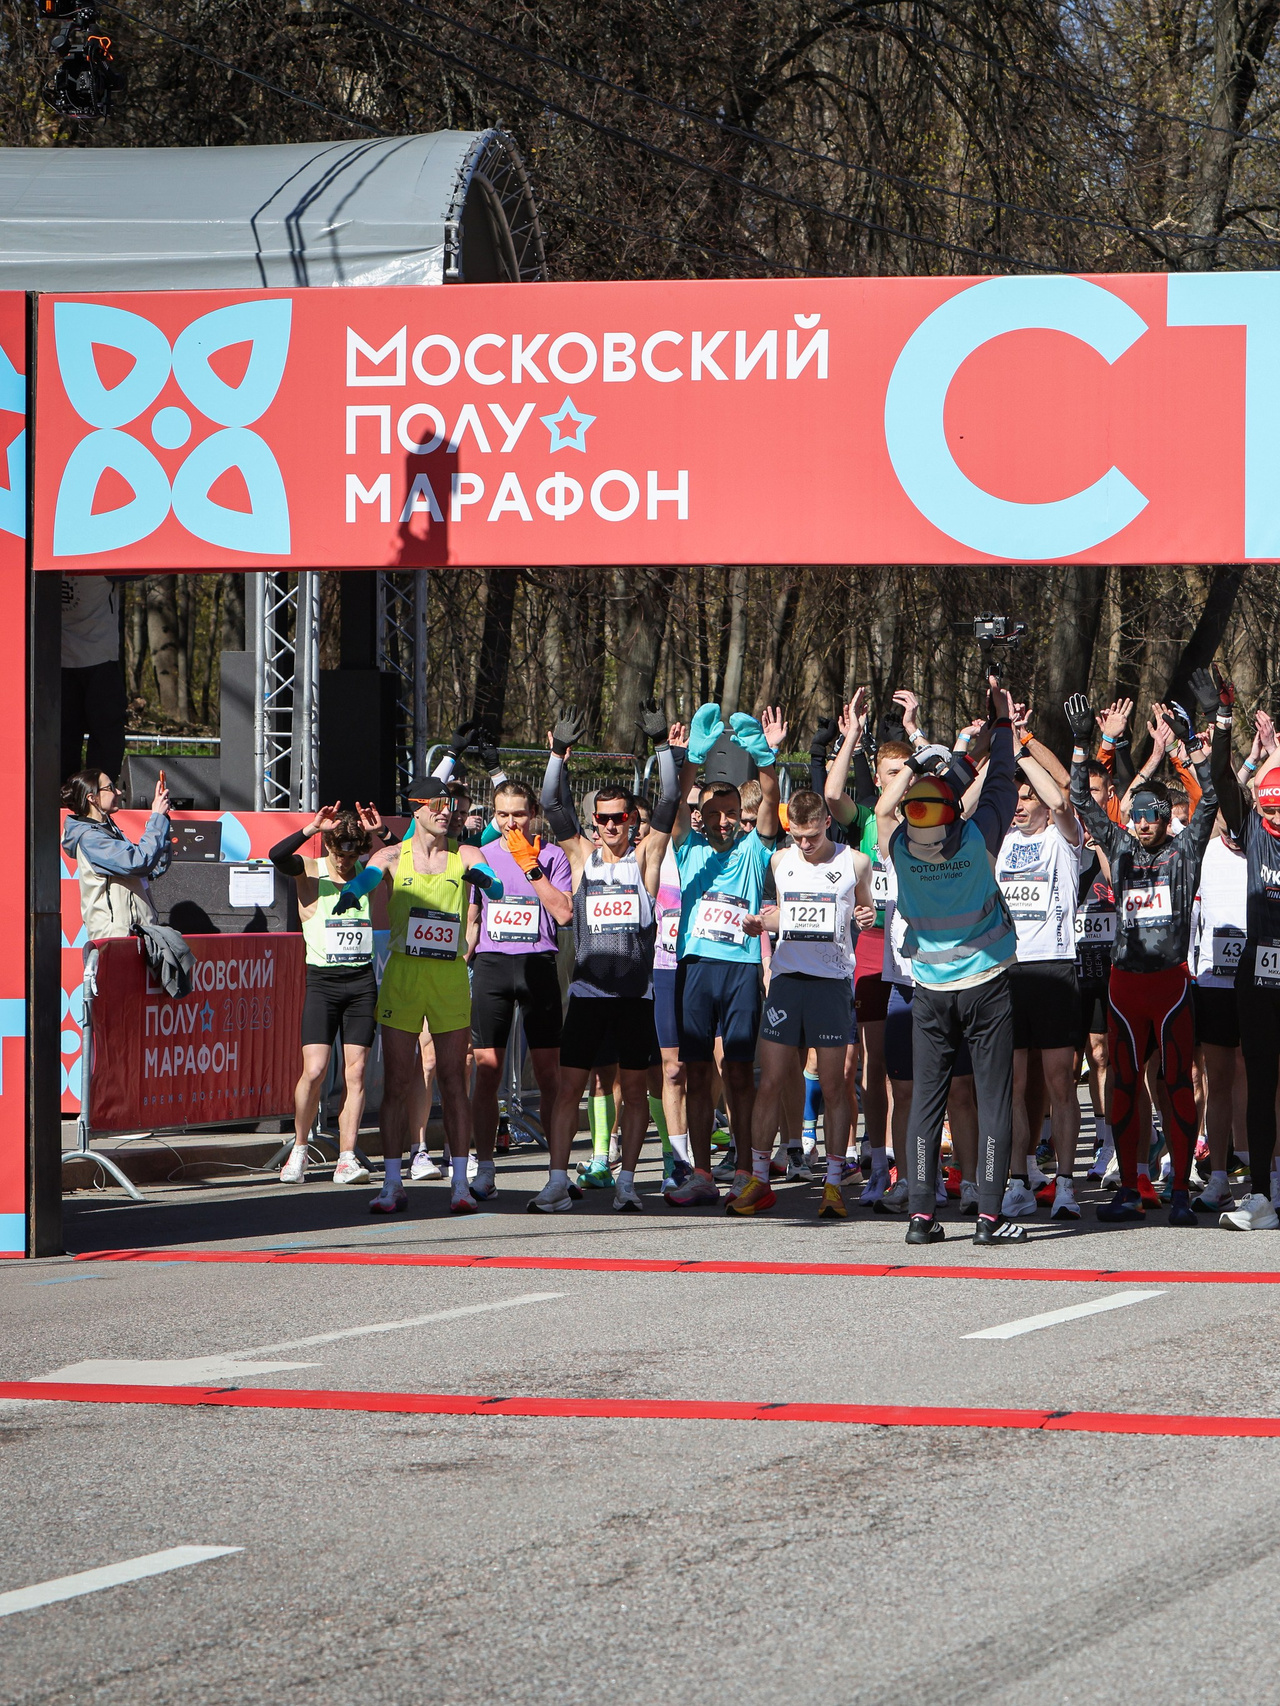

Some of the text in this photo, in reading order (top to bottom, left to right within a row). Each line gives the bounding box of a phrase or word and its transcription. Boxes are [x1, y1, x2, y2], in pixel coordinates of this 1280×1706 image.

[346, 313, 830, 387] МОСКОВСКИЙ
[346, 403, 536, 454] ПОЛУ
[346, 469, 690, 523] МАРАФОН
[910, 860, 970, 873] ФОТО/ВИДЕО
[1005, 887, 1040, 901] 4486
[1126, 893, 1162, 911] 6941
[594, 901, 632, 917] 6682
[704, 908, 740, 927] 6794
[790, 907, 826, 922] 1221
[494, 911, 532, 926] 6429
[1075, 918, 1110, 933] 3861
[337, 932, 362, 945] 799
[414, 925, 453, 943] 6633
[146, 996, 272, 1036] ПОЛУ 2026
[145, 1042, 238, 1078] МАРАФОН
[143, 1093, 183, 1106] ВРЕМЯ
[917, 1137, 926, 1182] INSANITY
[985, 1136, 996, 1182] INSANITY
